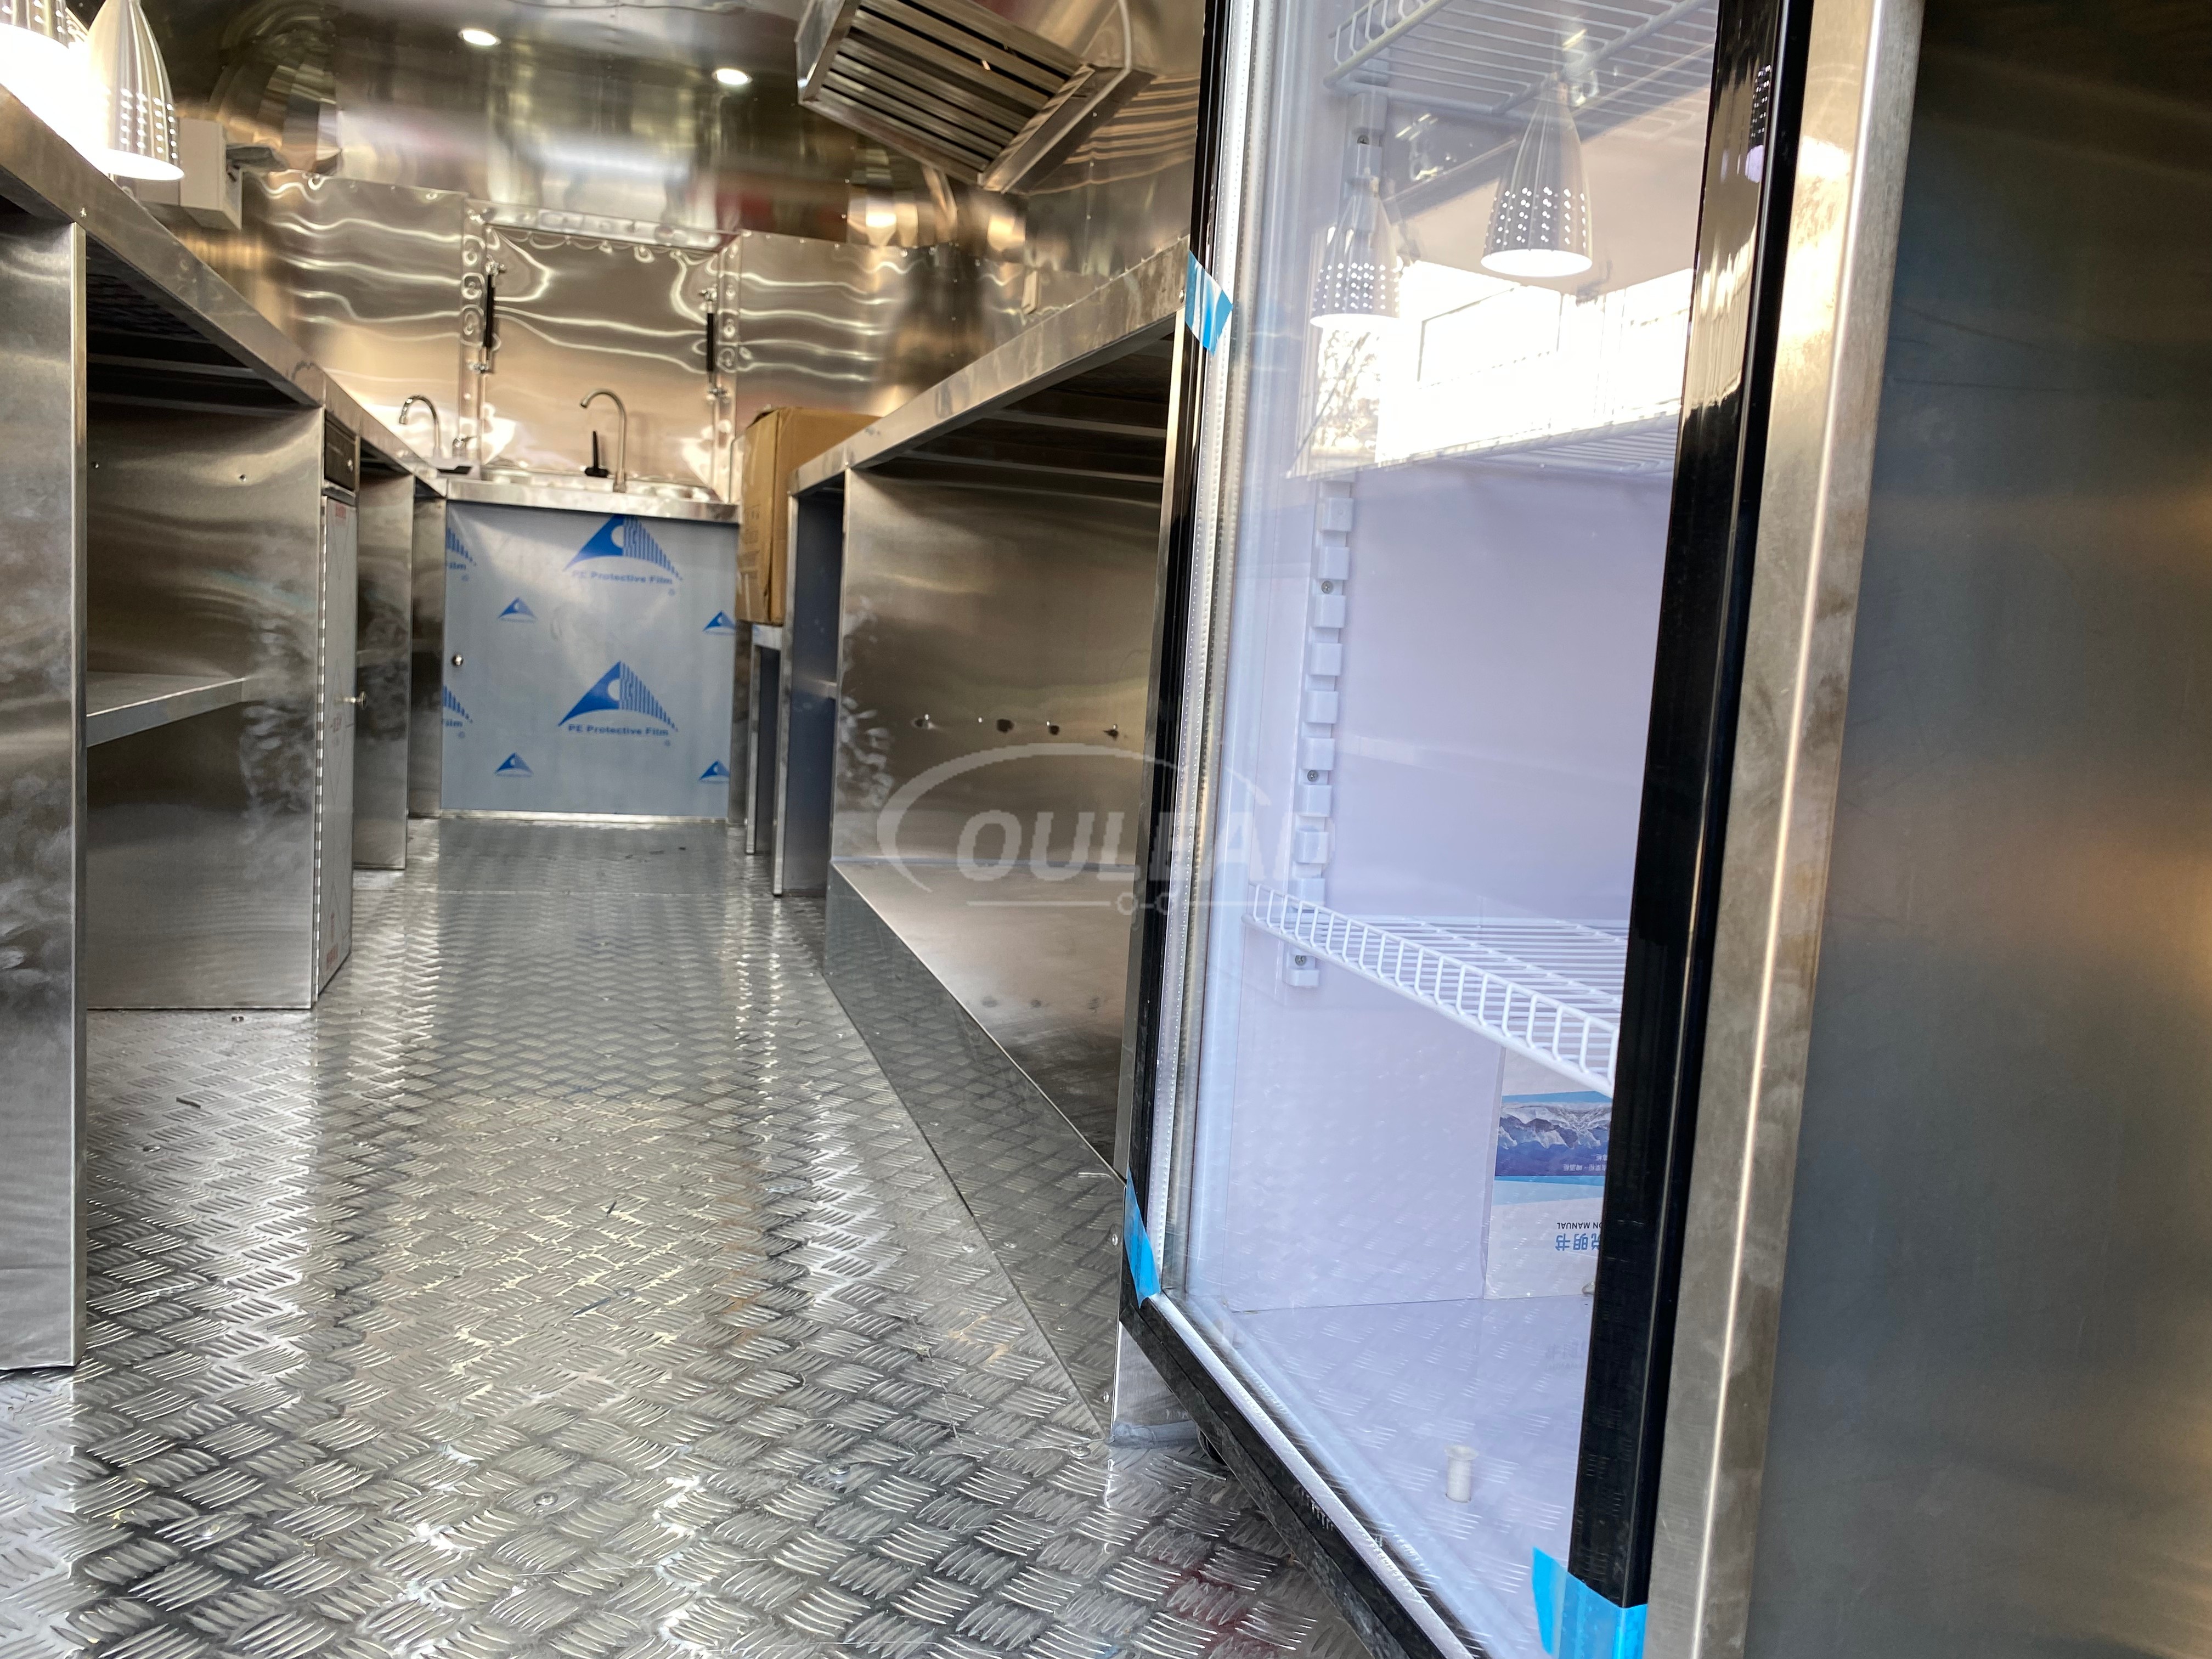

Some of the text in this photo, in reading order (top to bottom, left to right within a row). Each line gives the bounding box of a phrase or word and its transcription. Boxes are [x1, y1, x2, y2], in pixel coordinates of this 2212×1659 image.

[590, 571, 646, 583] Protective
[650, 576, 673, 585] Film
[568, 724, 669, 736] PE Protective Film
